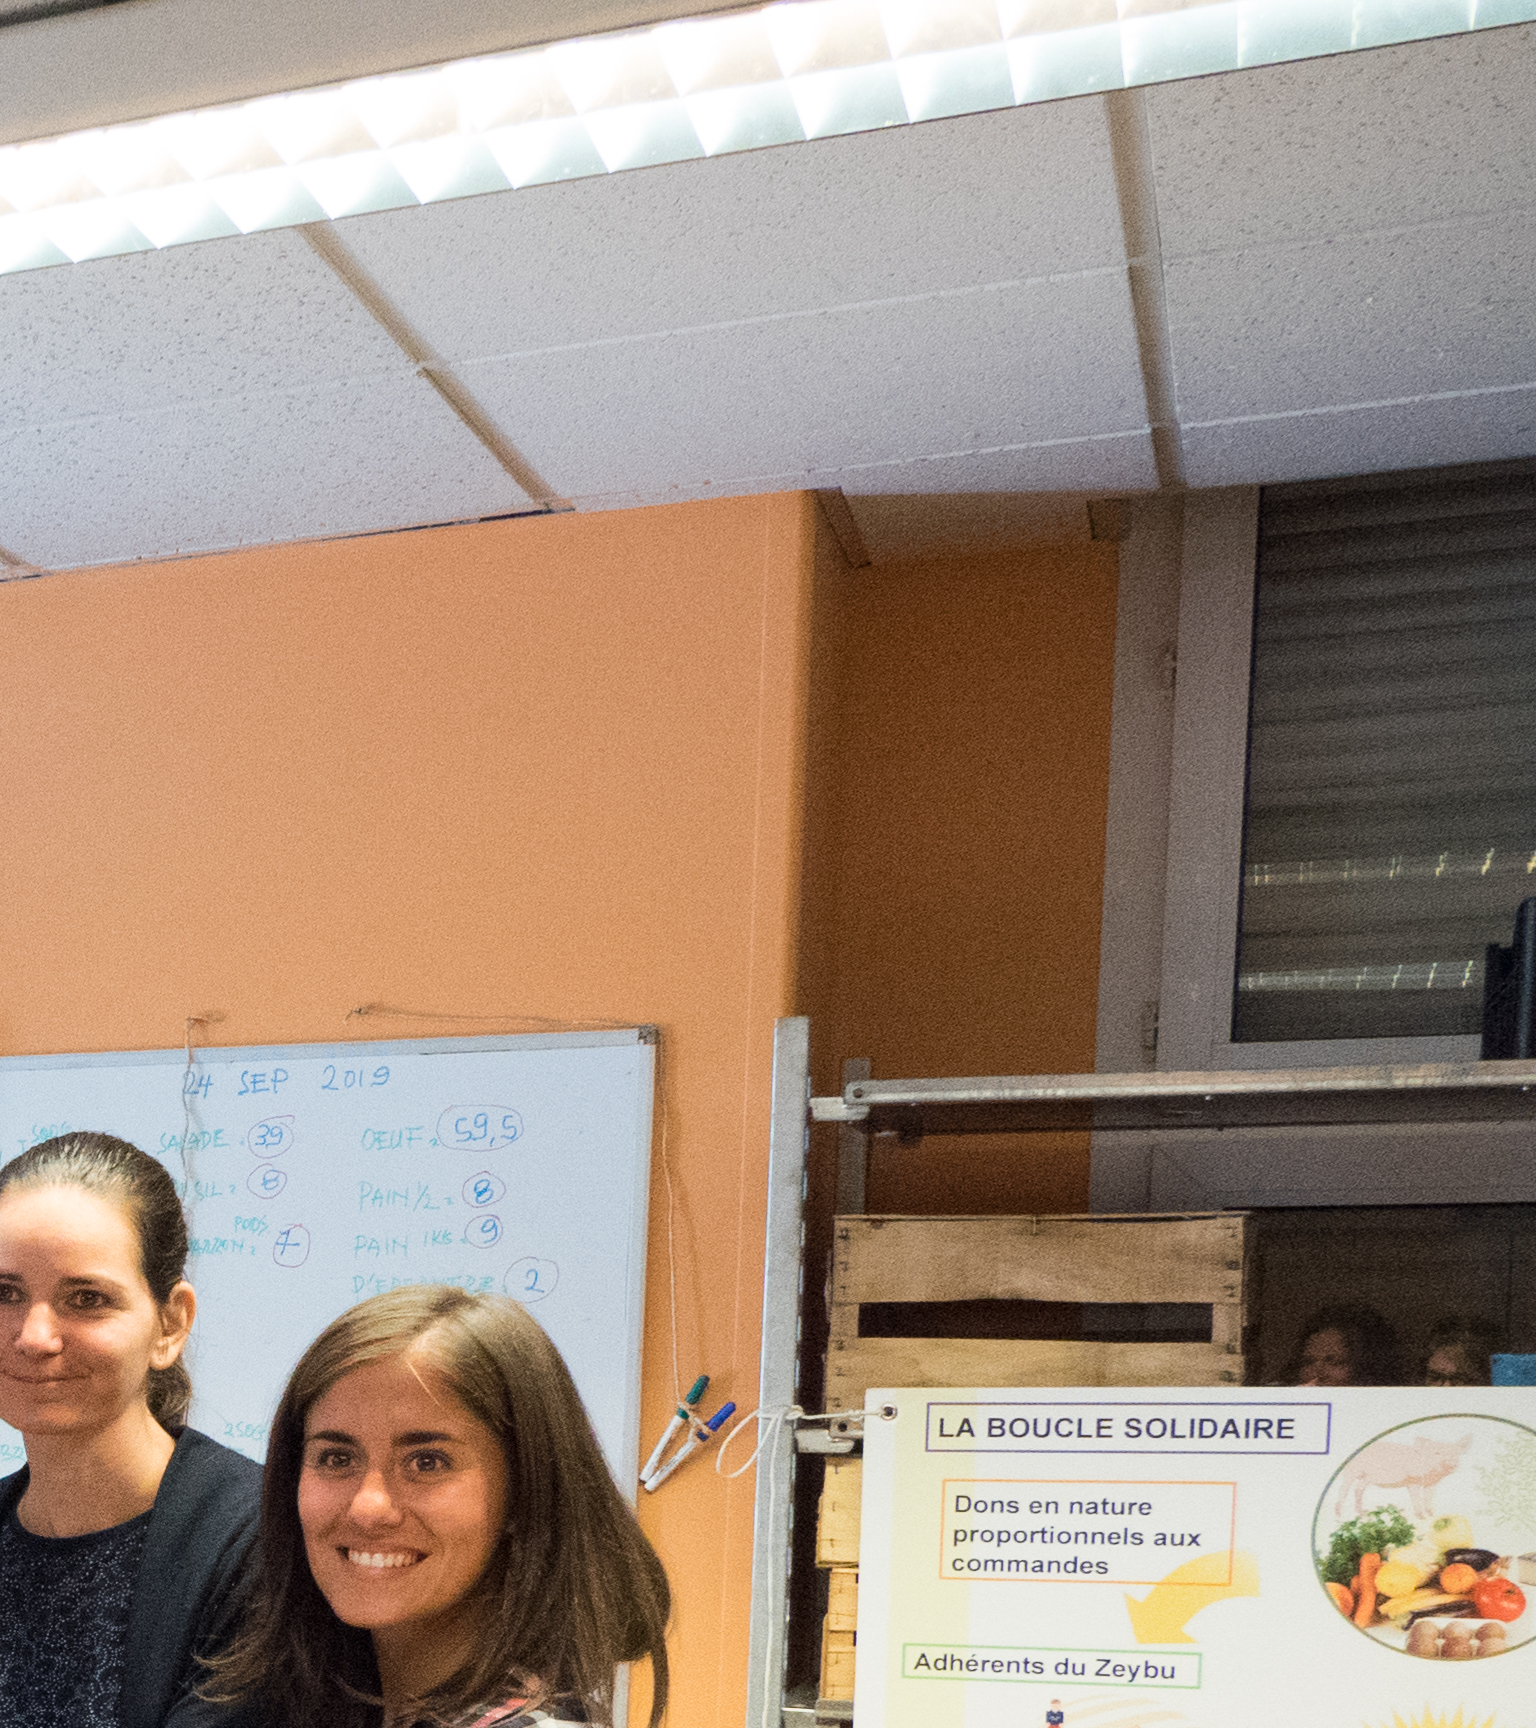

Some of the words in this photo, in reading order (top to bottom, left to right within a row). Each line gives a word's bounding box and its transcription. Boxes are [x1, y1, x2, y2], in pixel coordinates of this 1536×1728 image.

[238, 1068, 289, 1095] SEP
[321, 1064, 390, 1090] 2019
[254, 1123, 284, 1150] 39
[360, 1126, 424, 1150] OEUF
[473, 1178, 494, 1205] 8
[354, 1234, 408, 1259] PAIN
[480, 1218, 499, 1245] 9
[525, 1268, 546, 1294] 2
[939, 1417, 975, 1439] LA
[987, 1416, 1114, 1440] BOUCLE
[1124, 1417, 1297, 1441] SOLIDAIRE
[954, 1494, 1020, 1516] Dons
[1028, 1500, 1060, 1516] en
[1069, 1497, 1153, 1518] nature
[952, 1525, 1146, 1551] proportionnels
[1153, 1530, 1202, 1550] aux
[951, 1554, 1110, 1576] commandes
[914, 1651, 1046, 1678] Adhérents
[1053, 1656, 1086, 1678] du
[1094, 1657, 1177, 1684] Zeybu
